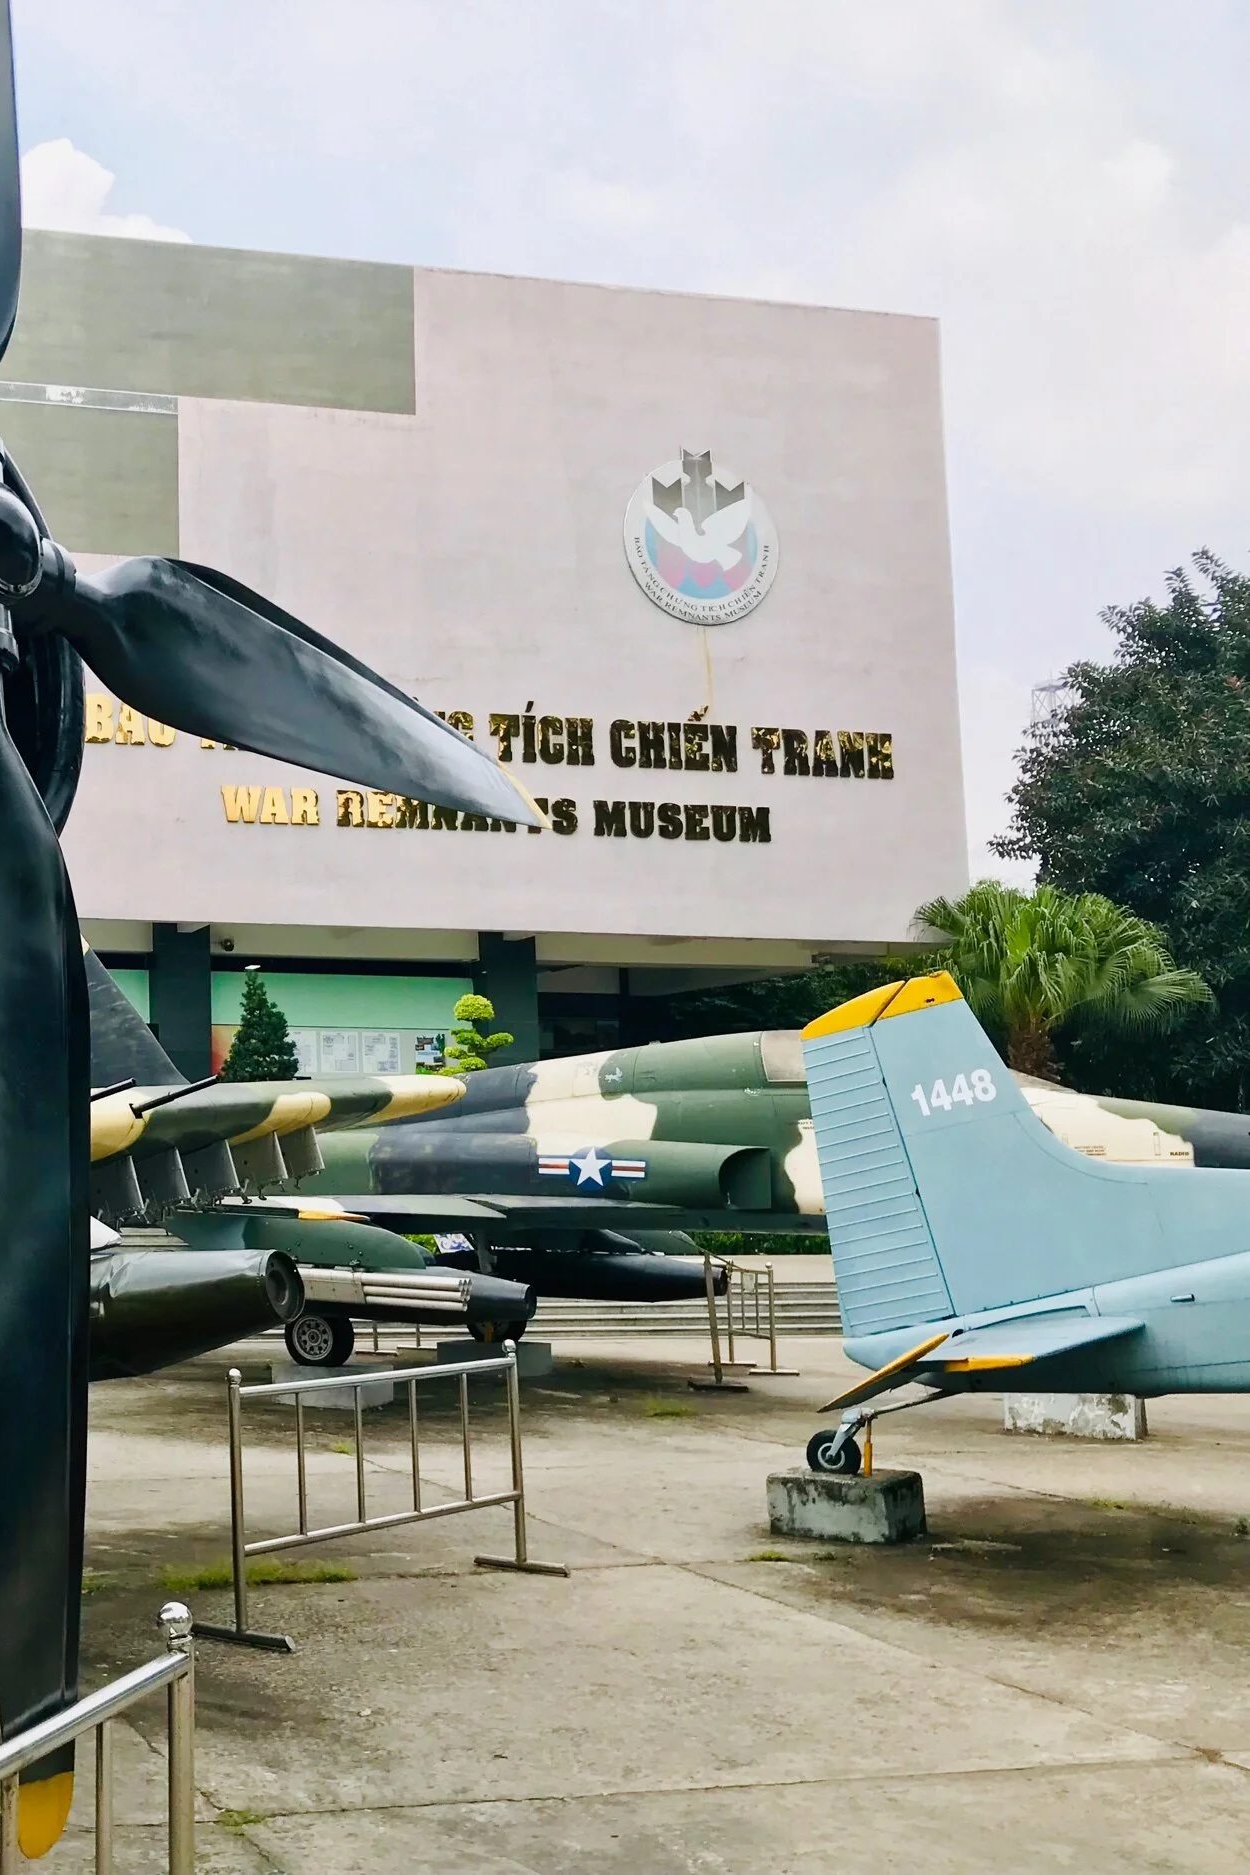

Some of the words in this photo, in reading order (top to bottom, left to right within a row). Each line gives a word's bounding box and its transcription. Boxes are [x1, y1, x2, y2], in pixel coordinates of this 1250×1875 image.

[645, 581, 663, 603] WAR
[664, 601, 722, 621] REMNANTS
[724, 590, 762, 618] MUSEUM
[489, 701, 595, 766] TÍCH
[751, 726, 895, 780] TRANH
[221, 785, 320, 826] WAR
[593, 799, 772, 843] MUSEUM
[910, 1068, 997, 1117] 1448
